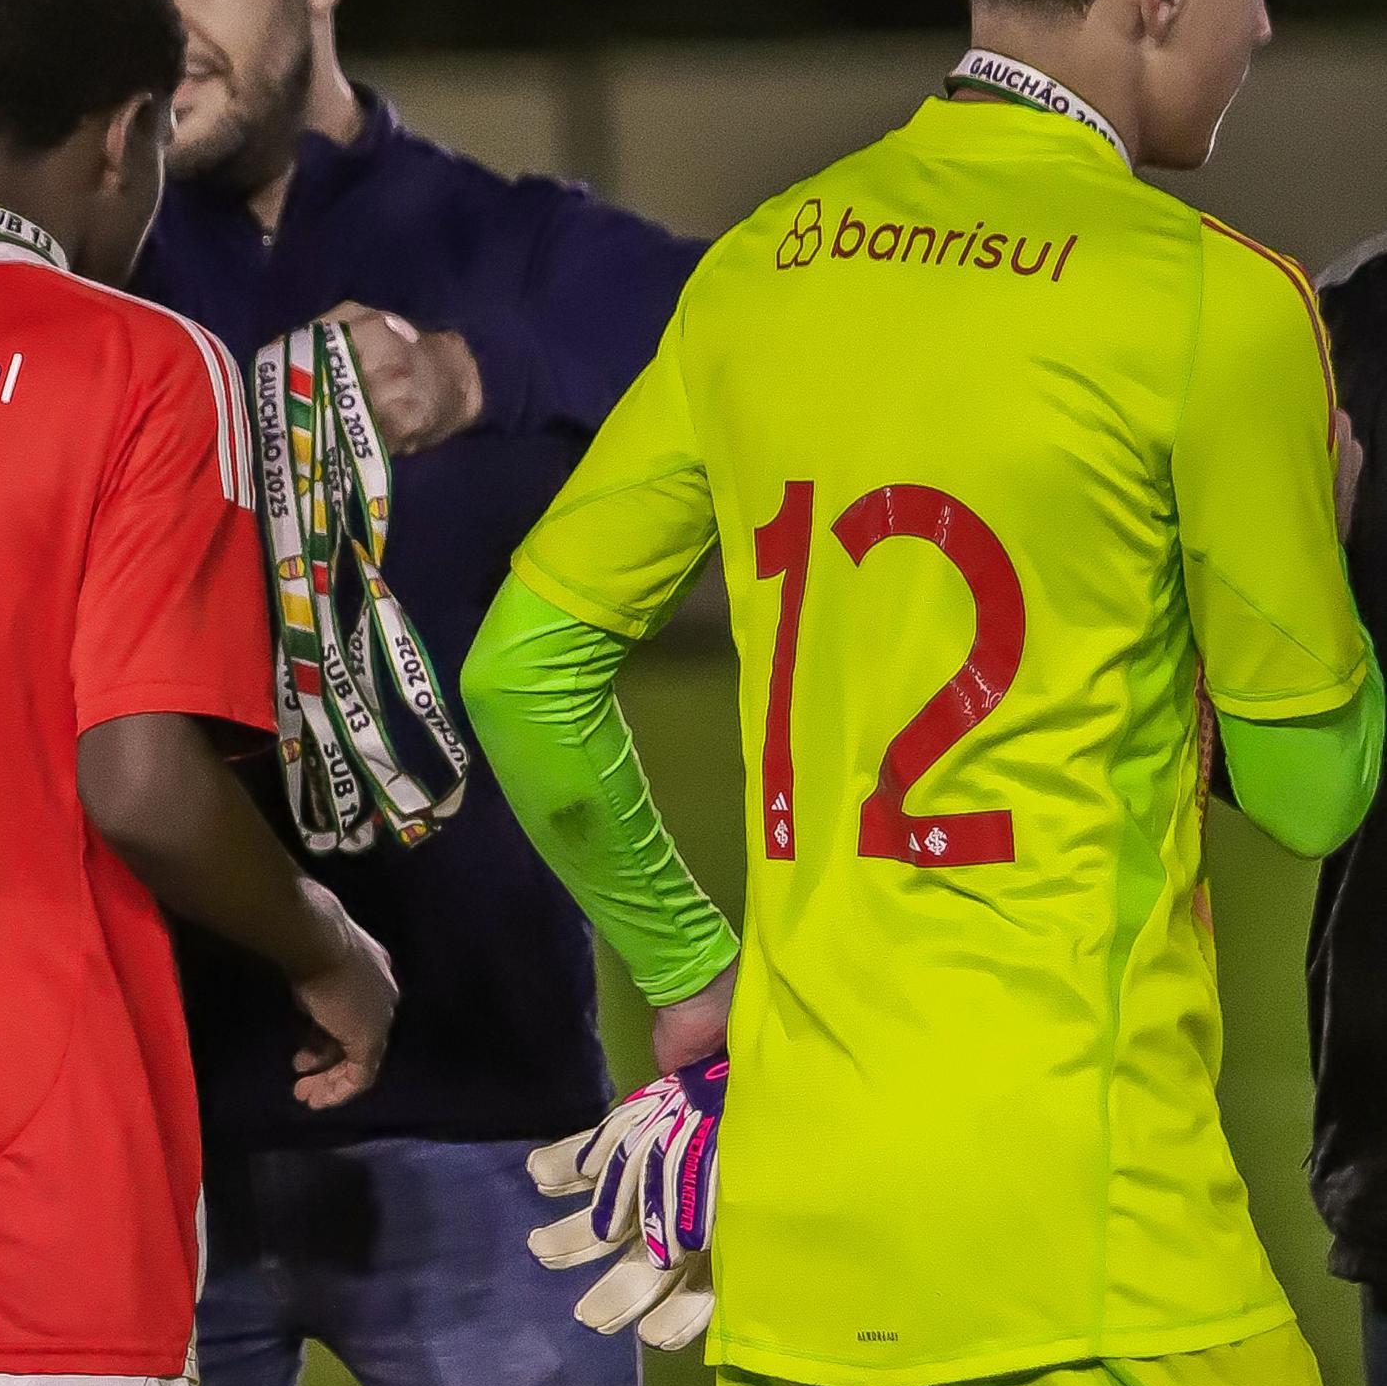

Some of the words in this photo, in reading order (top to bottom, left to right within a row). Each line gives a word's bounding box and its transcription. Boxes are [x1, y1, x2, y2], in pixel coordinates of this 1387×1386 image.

[969, 57, 1070, 114] GAUCHÃO
[30, 226, 53, 253] 13
[831, 206, 1078, 282] banrisul
[259, 362, 286, 462] GAUCHÃO
[266, 465, 289, 519] 2025
[322, 643, 355, 700] SUB
[345, 702, 371, 734] 13
[395, 634, 426, 688] 2025
[754, 481, 1026, 867] 12
[324, 742, 356, 800] SUB
